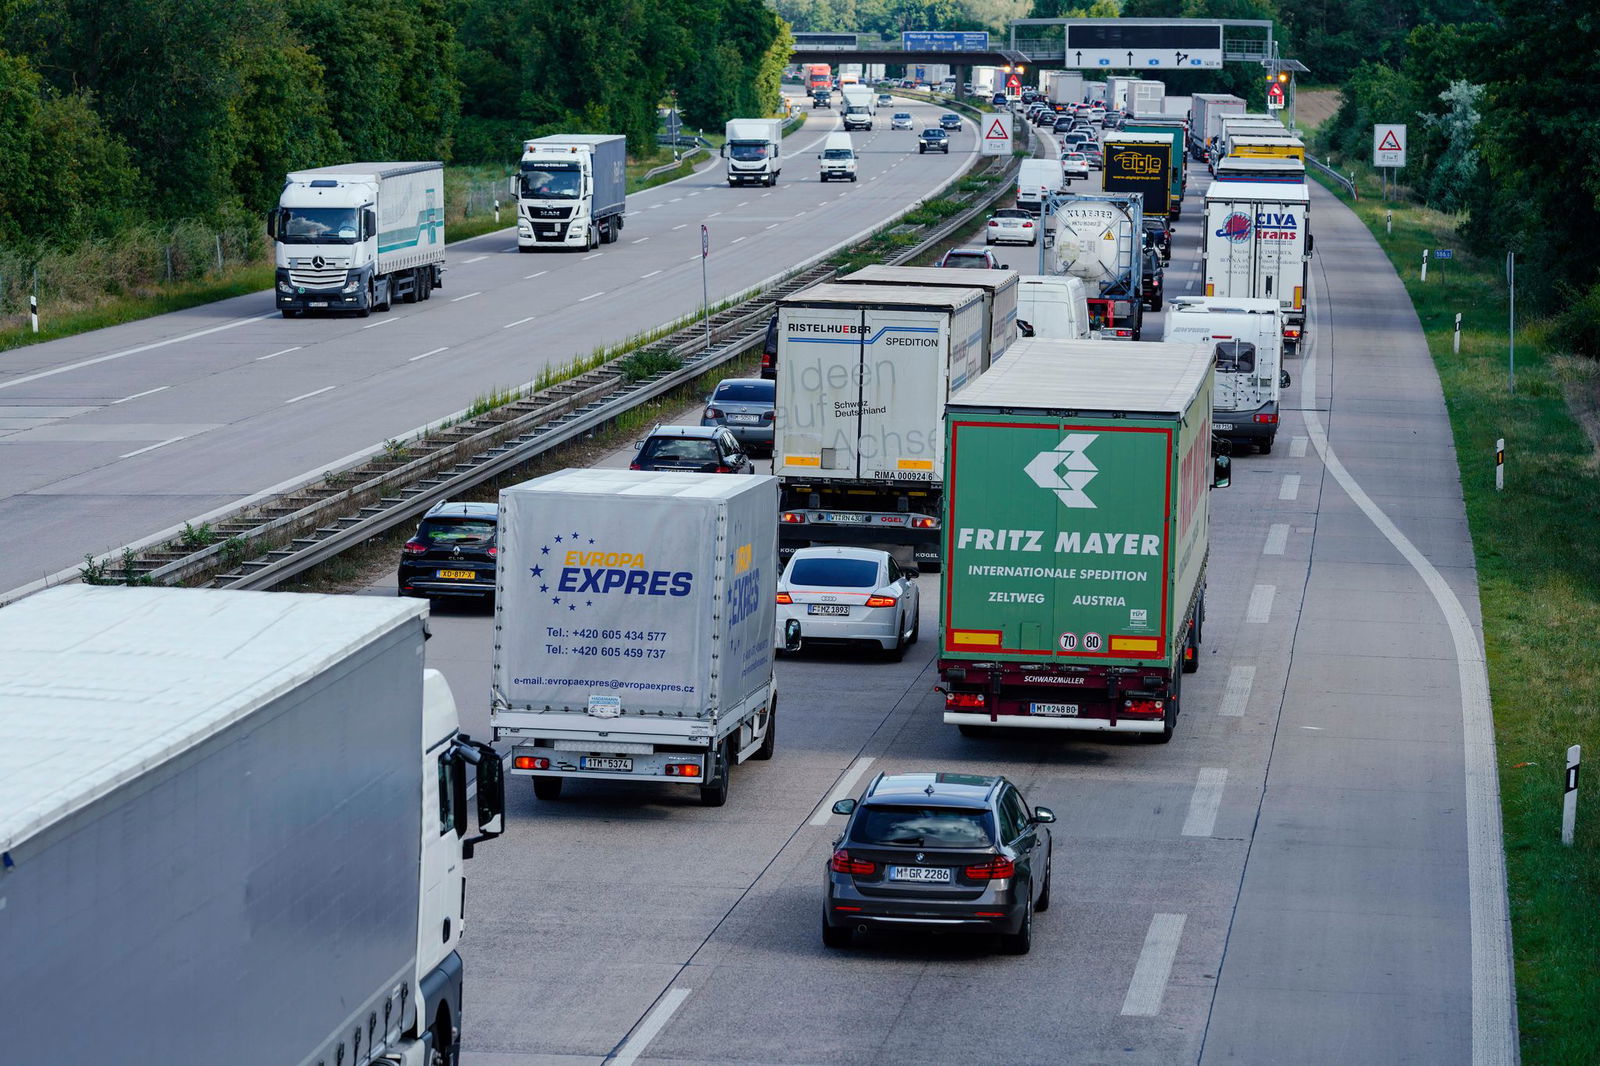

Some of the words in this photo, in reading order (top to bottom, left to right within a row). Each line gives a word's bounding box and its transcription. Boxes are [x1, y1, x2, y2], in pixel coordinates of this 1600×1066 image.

[1257, 213, 1297, 226] CIVA
[1256, 230, 1297, 240] trans
[788, 323, 872, 334] RISTELHUEBER
[885, 337, 939, 348] SPEDITION
[788, 357, 896, 393] Ideen
[834, 400, 868, 410] Schwez
[835, 406, 887, 418] Deutshland
[874, 471, 896, 480] RIMA
[897, 471, 926, 481] 000924
[927, 473, 934, 481] 6
[957, 528, 1045, 552] FRITZ
[1054, 531, 1160, 556] MAYER
[564, 551, 645, 569] EVROPA
[968, 565, 1076, 579] INTERNATIONALE
[1079, 569, 1147, 582] SPEDITION
[558, 567, 694, 597] EXPRES
[988, 592, 1045, 604] ZELTWEG
[1072, 595, 1126, 607] AUSTRIA
[546, 627, 570, 638] Tel.:
[572, 629, 599, 640] +420
[601, 629, 622, 640] 605
[624, 631, 644, 641] 434
[647, 631, 667, 642] 577
[1063, 635, 1075, 648] 70
[1086, 636, 1099, 649] 80
[545, 644, 569, 655] Tel.:
[571, 646, 598, 656] +420
[601, 647, 621, 657] 605
[623, 648, 644, 659] 459
[646, 649, 666, 659] 737
[608, 759, 628, 769] 5374
[896, 867, 903, 878] M
[909, 868, 922, 879] GR
[924, 869, 949, 880] 2286
